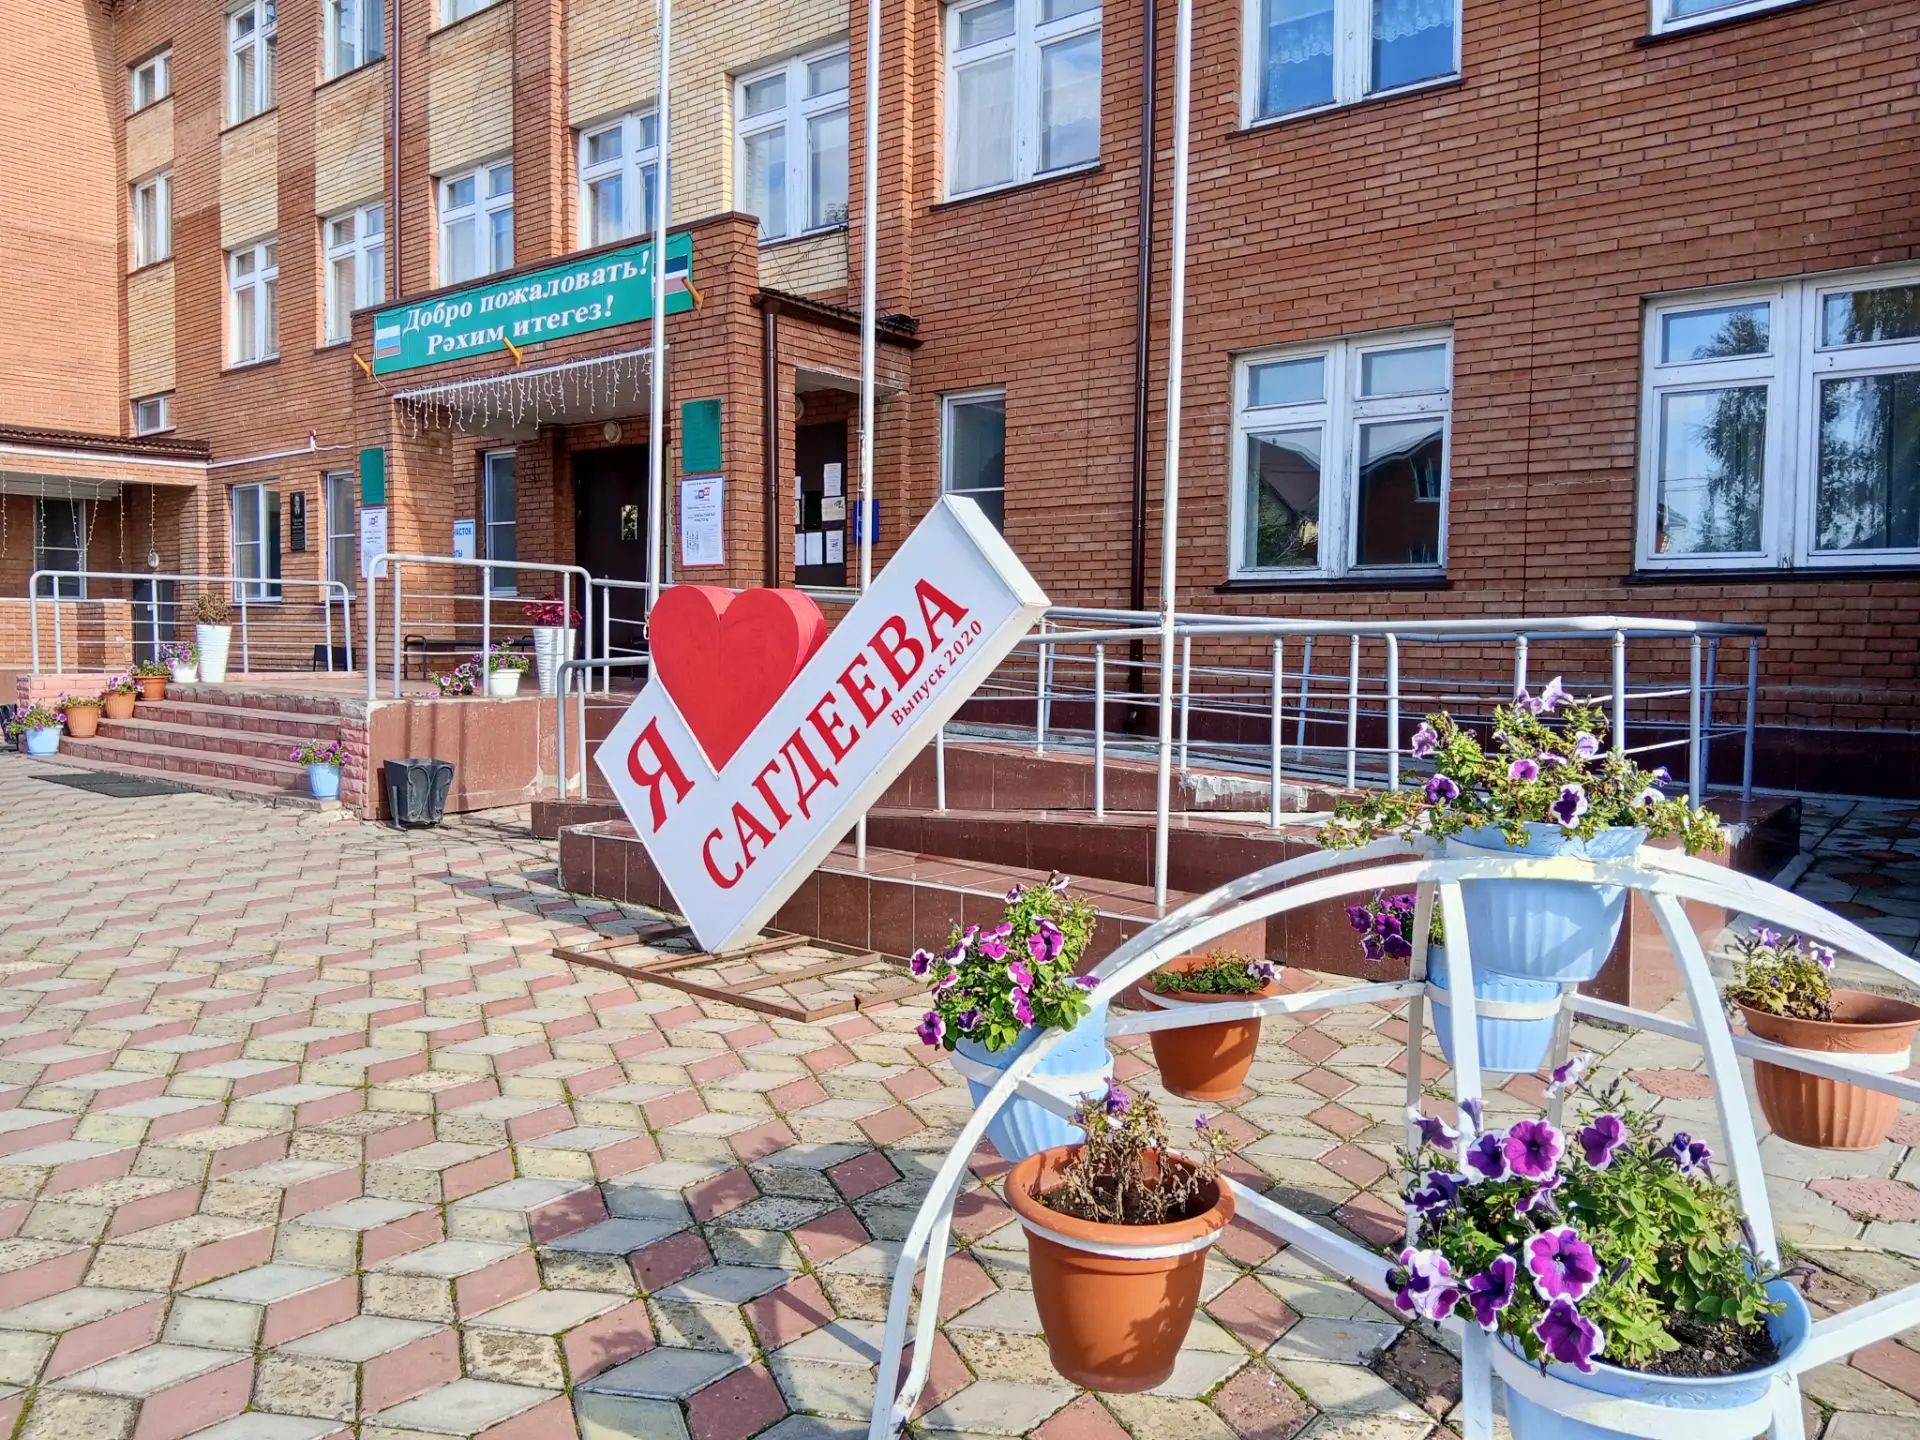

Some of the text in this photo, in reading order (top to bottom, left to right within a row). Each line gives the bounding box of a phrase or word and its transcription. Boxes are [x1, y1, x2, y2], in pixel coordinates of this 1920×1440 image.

[402, 250, 650, 334] Добро пожаловать!
[427, 294, 615, 356] Рәхим итегез!
[890, 618, 984, 727] Выпуск 2020
[626, 716, 696, 834] Я
[701, 577, 970, 890] САГДЕЕВА
